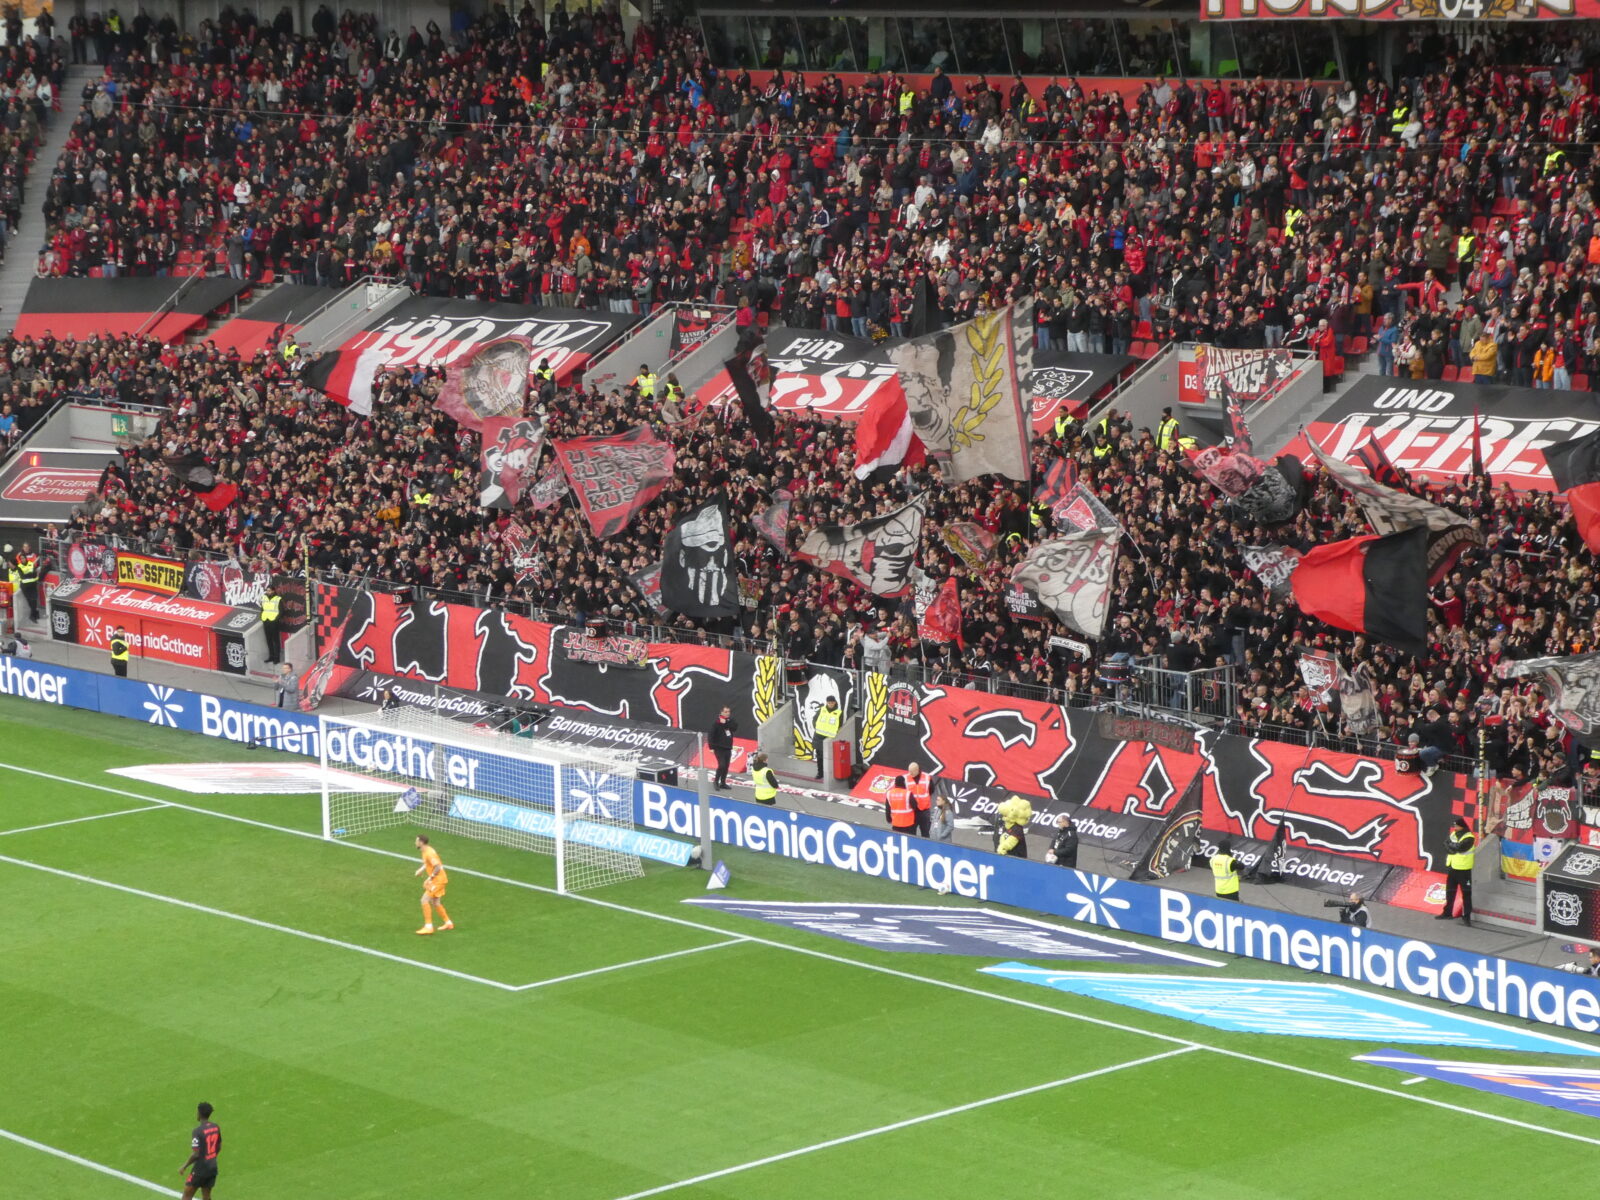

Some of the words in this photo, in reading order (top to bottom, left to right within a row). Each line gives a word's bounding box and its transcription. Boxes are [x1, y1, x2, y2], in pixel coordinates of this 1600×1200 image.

[780, 337, 844, 360] FÜR
[1373, 387, 1455, 412] UND
[112, 589, 215, 620] BarmeniaGothaer
[1011, 605, 1028, 614] SVB
[106, 625, 204, 658] BmeniaGothaer
[201, 695, 480, 789] BarmenaGother
[548, 715, 675, 751] BarmeniaGothaer
[513, 810, 557, 834] NIEDA
[570, 822, 627, 848] NIEDAX
[631, 836, 690, 861] NIEDAX
[642, 783, 995, 899] BarmeniaGothaer
